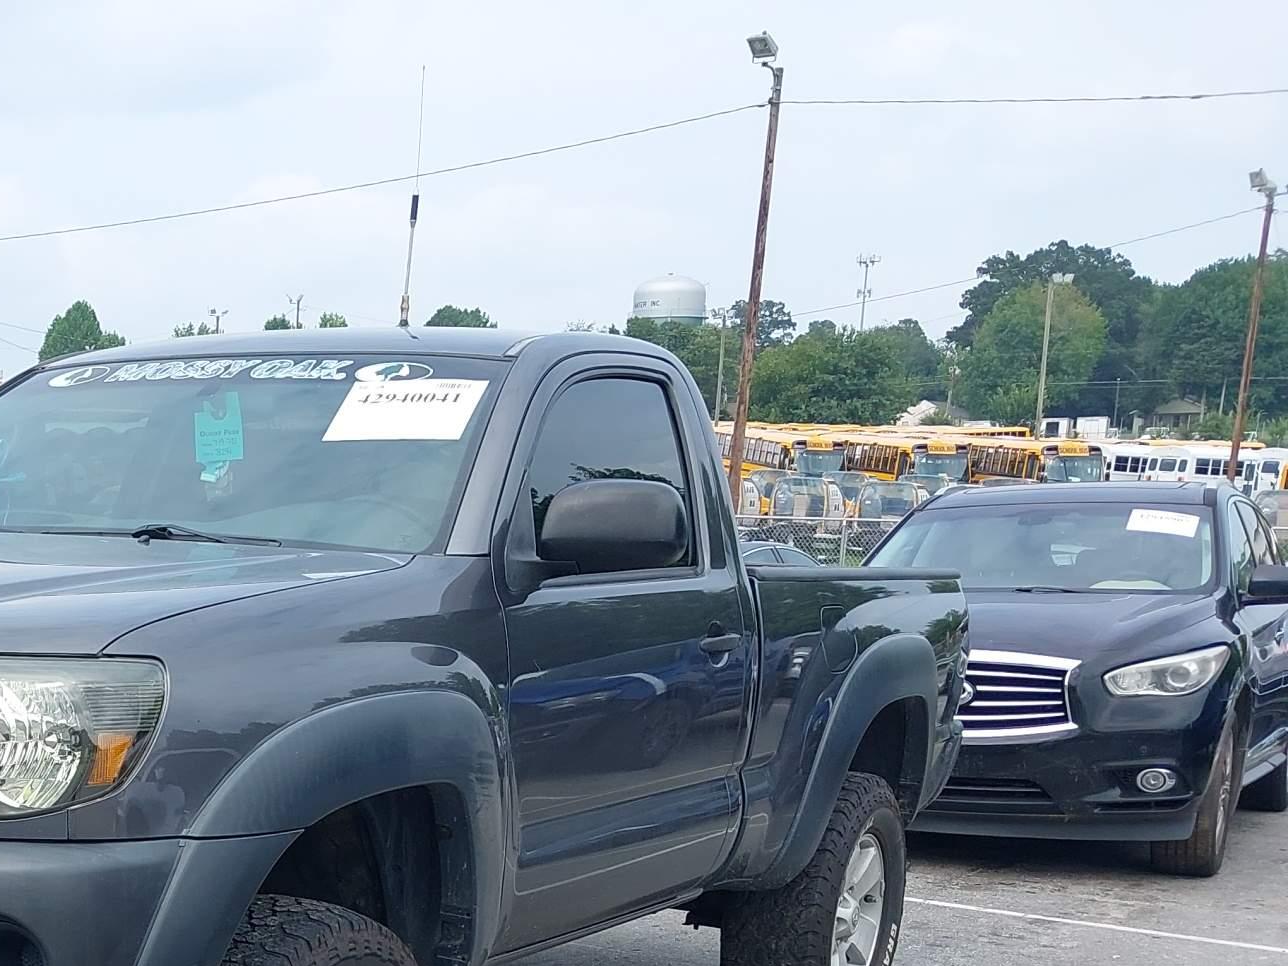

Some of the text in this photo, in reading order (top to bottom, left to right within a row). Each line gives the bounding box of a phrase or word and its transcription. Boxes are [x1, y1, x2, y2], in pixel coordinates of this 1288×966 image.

[104, 359, 354, 383] MOSSY OAK
[358, 392, 462, 404] 42940041
